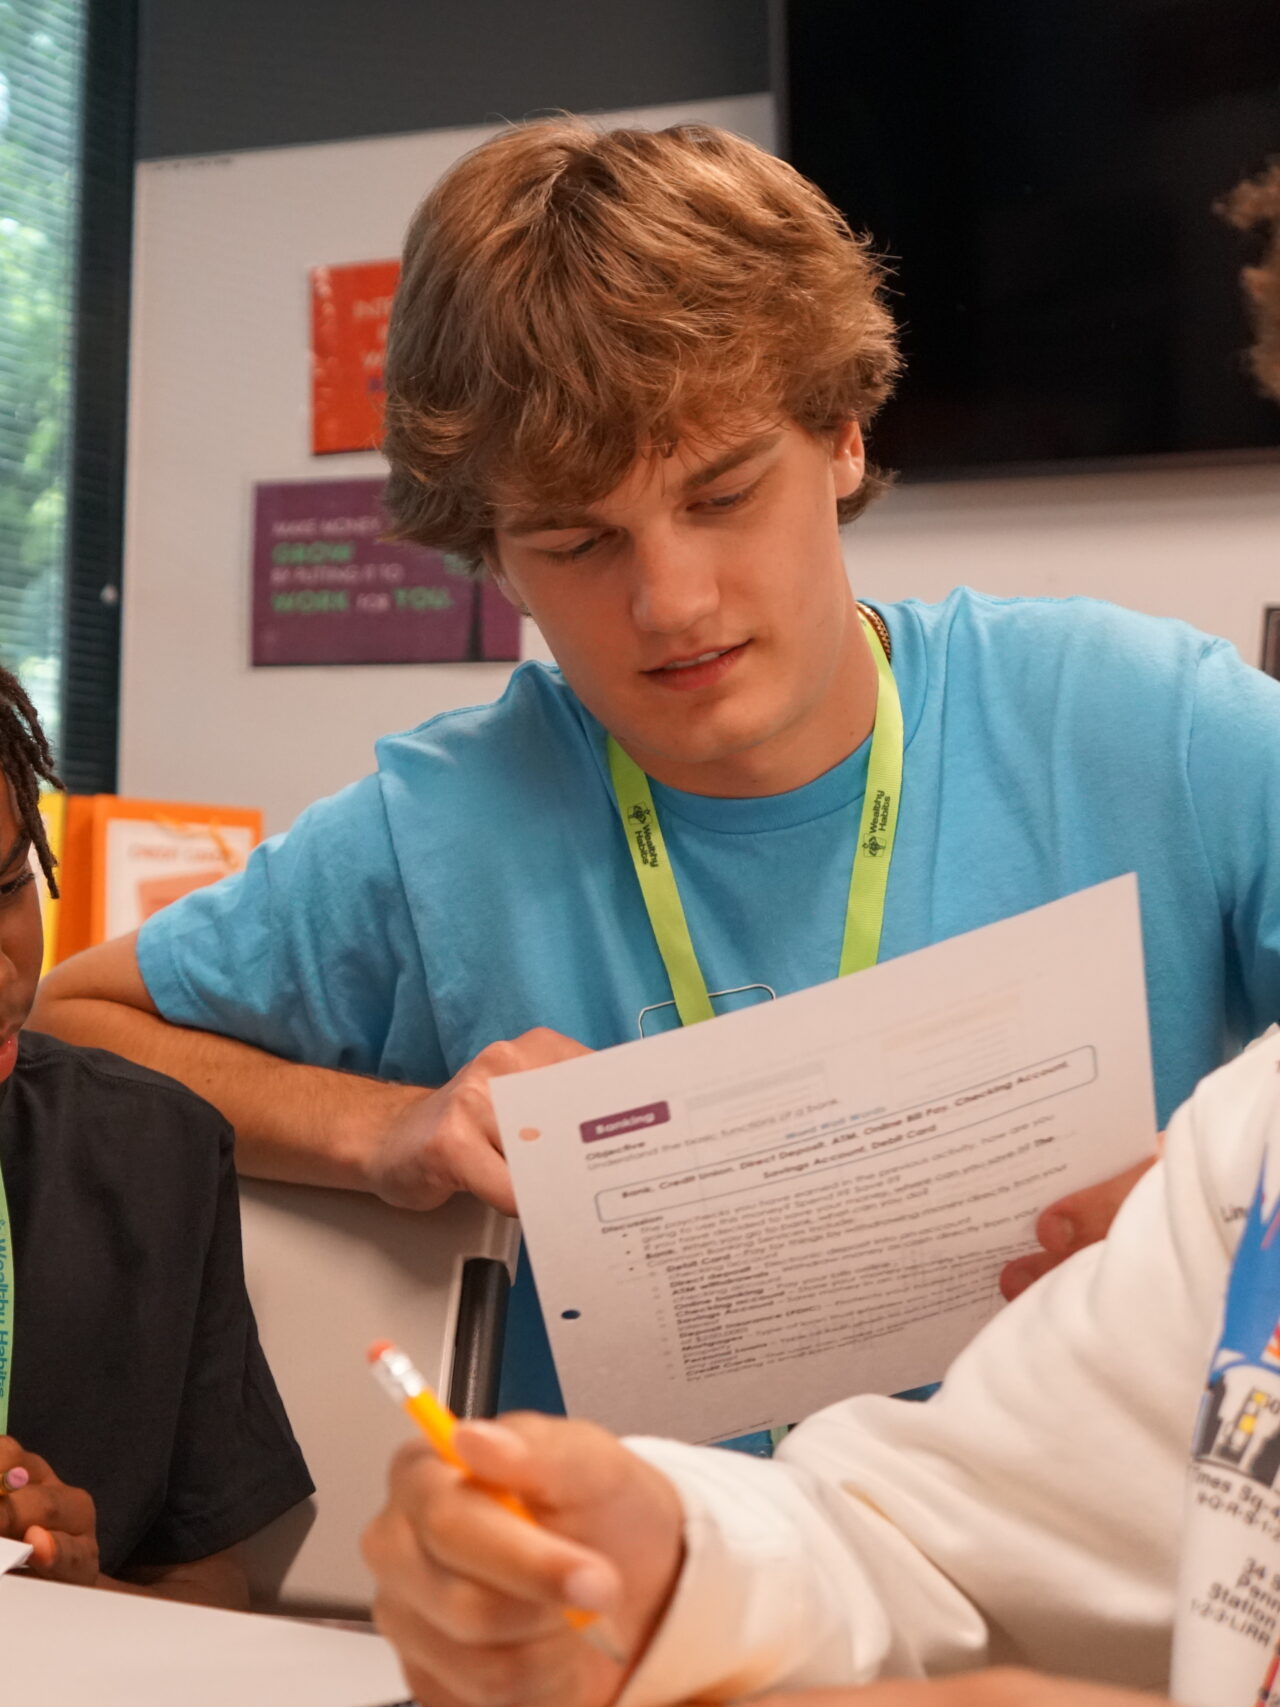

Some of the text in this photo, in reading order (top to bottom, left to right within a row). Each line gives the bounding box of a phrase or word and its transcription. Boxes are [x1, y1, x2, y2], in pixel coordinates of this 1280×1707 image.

[272, 540, 354, 565] GROW
[272, 590, 349, 613] WORK
[869, 789, 886, 834] Wealthy
[878, 795, 891, 832] Habits
[634, 830, 649, 866] Habits
[642, 823, 659, 868] Wealthy
[594, 1111, 656, 1135] Banking
[658, 1173, 696, 1190] Credit
[739, 1153, 776, 1170] Direct
[863, 1117, 902, 1135] Online
[906, 1110, 922, 1122] Bill
[953, 1080, 1013, 1107] Checking
[661, 1141, 681, 1152] the
[684, 1132, 716, 1146] basic
[720, 1115, 776, 1137] functions
[779, 1110, 792, 1121] of
[795, 1108, 804, 1117] a
[585, 1140, 646, 1162] Objective
[763, 1161, 809, 1179] Savings
[870, 1133, 903, 1150] Debit
[905, 1123, 937, 1139] Card
[1034, 1134, 1054, 1147] The
[601, 1215, 664, 1234] Discussion
[665, 1259, 698, 1273] Debit
[700, 1252, 731, 1265] Card
[668, 1274, 705, 1288] Direct
[706, 1264, 752, 1281] deposit
[671, 1285, 696, 1296] ATM
[673, 1298, 712, 1310] Online
